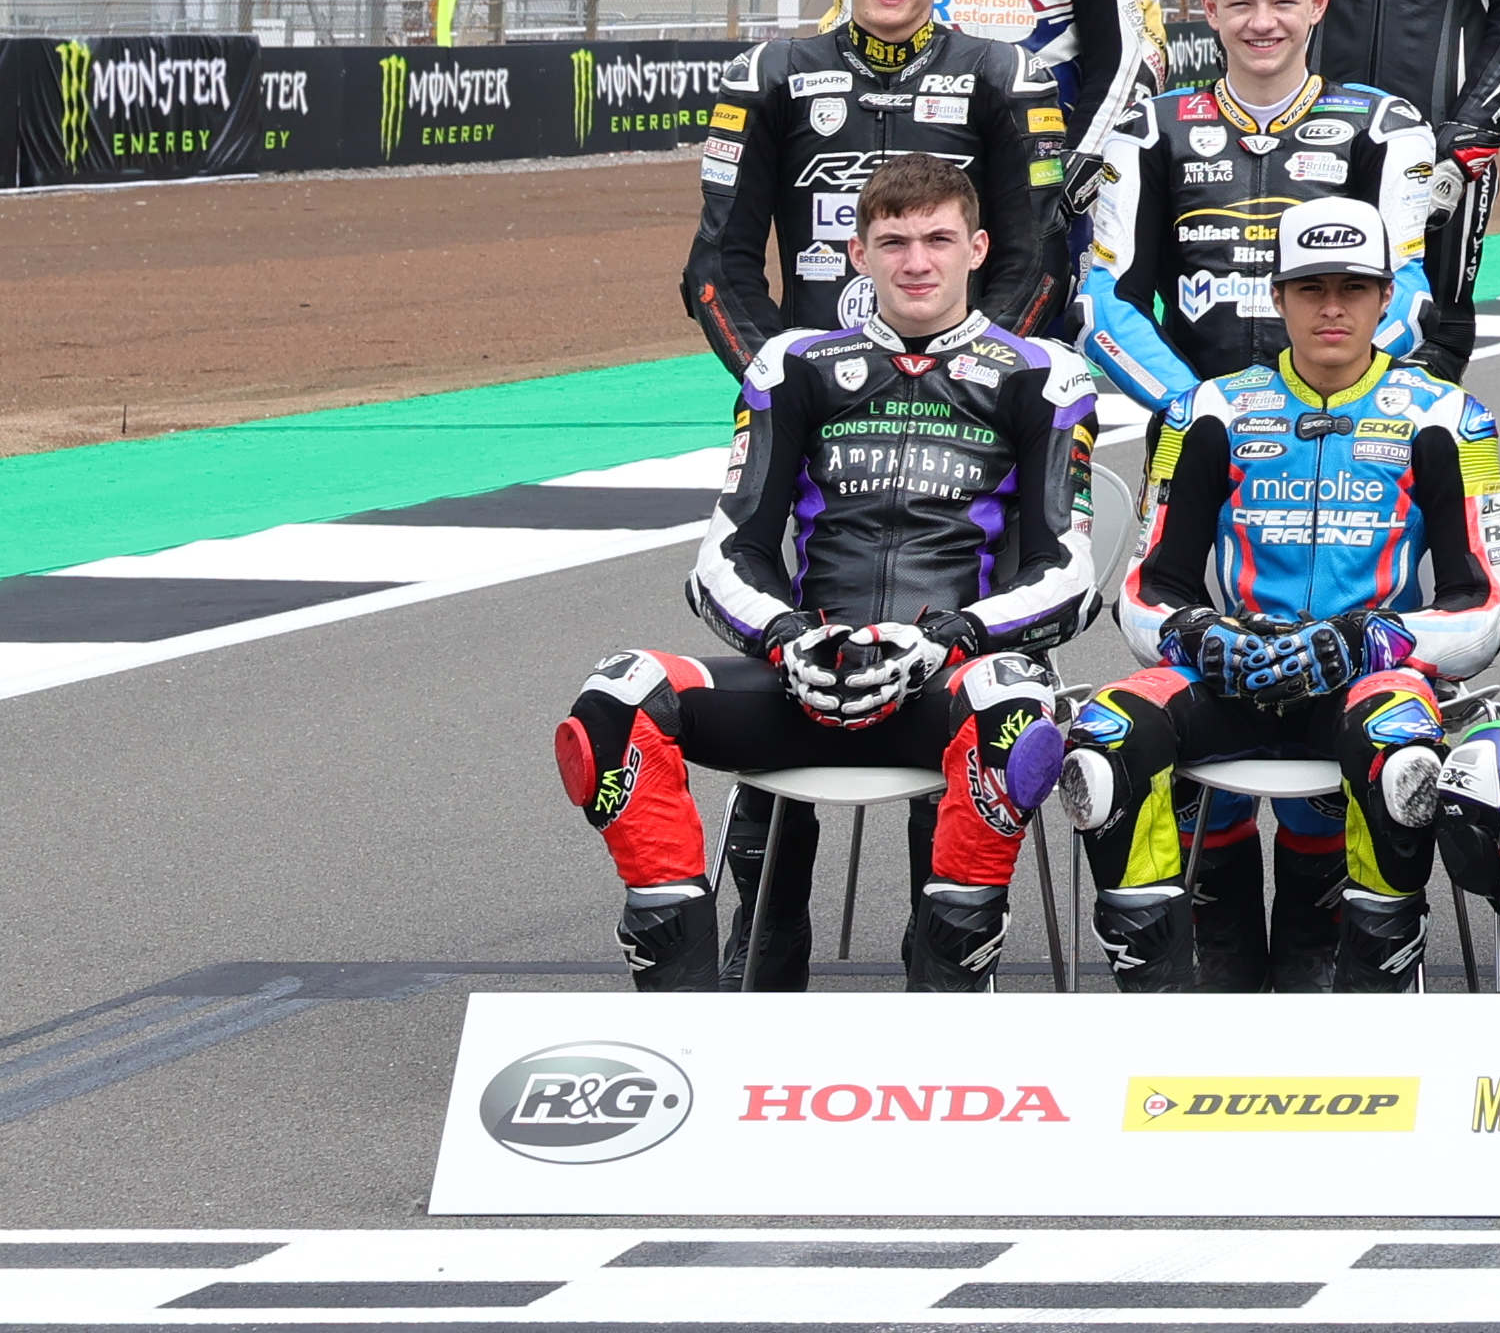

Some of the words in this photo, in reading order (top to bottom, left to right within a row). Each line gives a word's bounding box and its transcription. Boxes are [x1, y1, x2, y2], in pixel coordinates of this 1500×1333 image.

[94, 49, 230, 118] MONSTER
[409, 64, 511, 114] MONSTER
[806, 75, 848, 87] SHARK
[920, 75, 974, 93] R&G
[114, 131, 210, 155] ENERGY
[422, 124, 494, 144] ENERGY
[1184, 171, 1204, 182] AIR
[1207, 171, 1233, 182] BAG
[1179, 225, 1240, 242] Belfast
[799, 254, 843, 264] BREEDON
[1234, 247, 1274, 263] Hire
[870, 402, 880, 415] L
[886, 402, 951, 417] BROWN
[822, 421, 958, 439] CONSTRUCTION
[963, 426, 996, 444] LTD
[1237, 423, 1288, 433] Kawasaki
[1359, 421, 1412, 438] SDK4
[1356, 444, 1409, 457] MAXTON
[827, 445, 984, 482] Amphibian
[840, 478, 961, 500] SCAFFOLDING
[1251, 471, 1384, 502] microlise
[1232, 509, 1406, 528] CRESSWELL
[1261, 528, 1375, 545] RACING
[518, 1072, 658, 1125] R&G
[738, 1085, 1071, 1122] HONDA
[1183, 1093, 1400, 1117] DUNLOP
